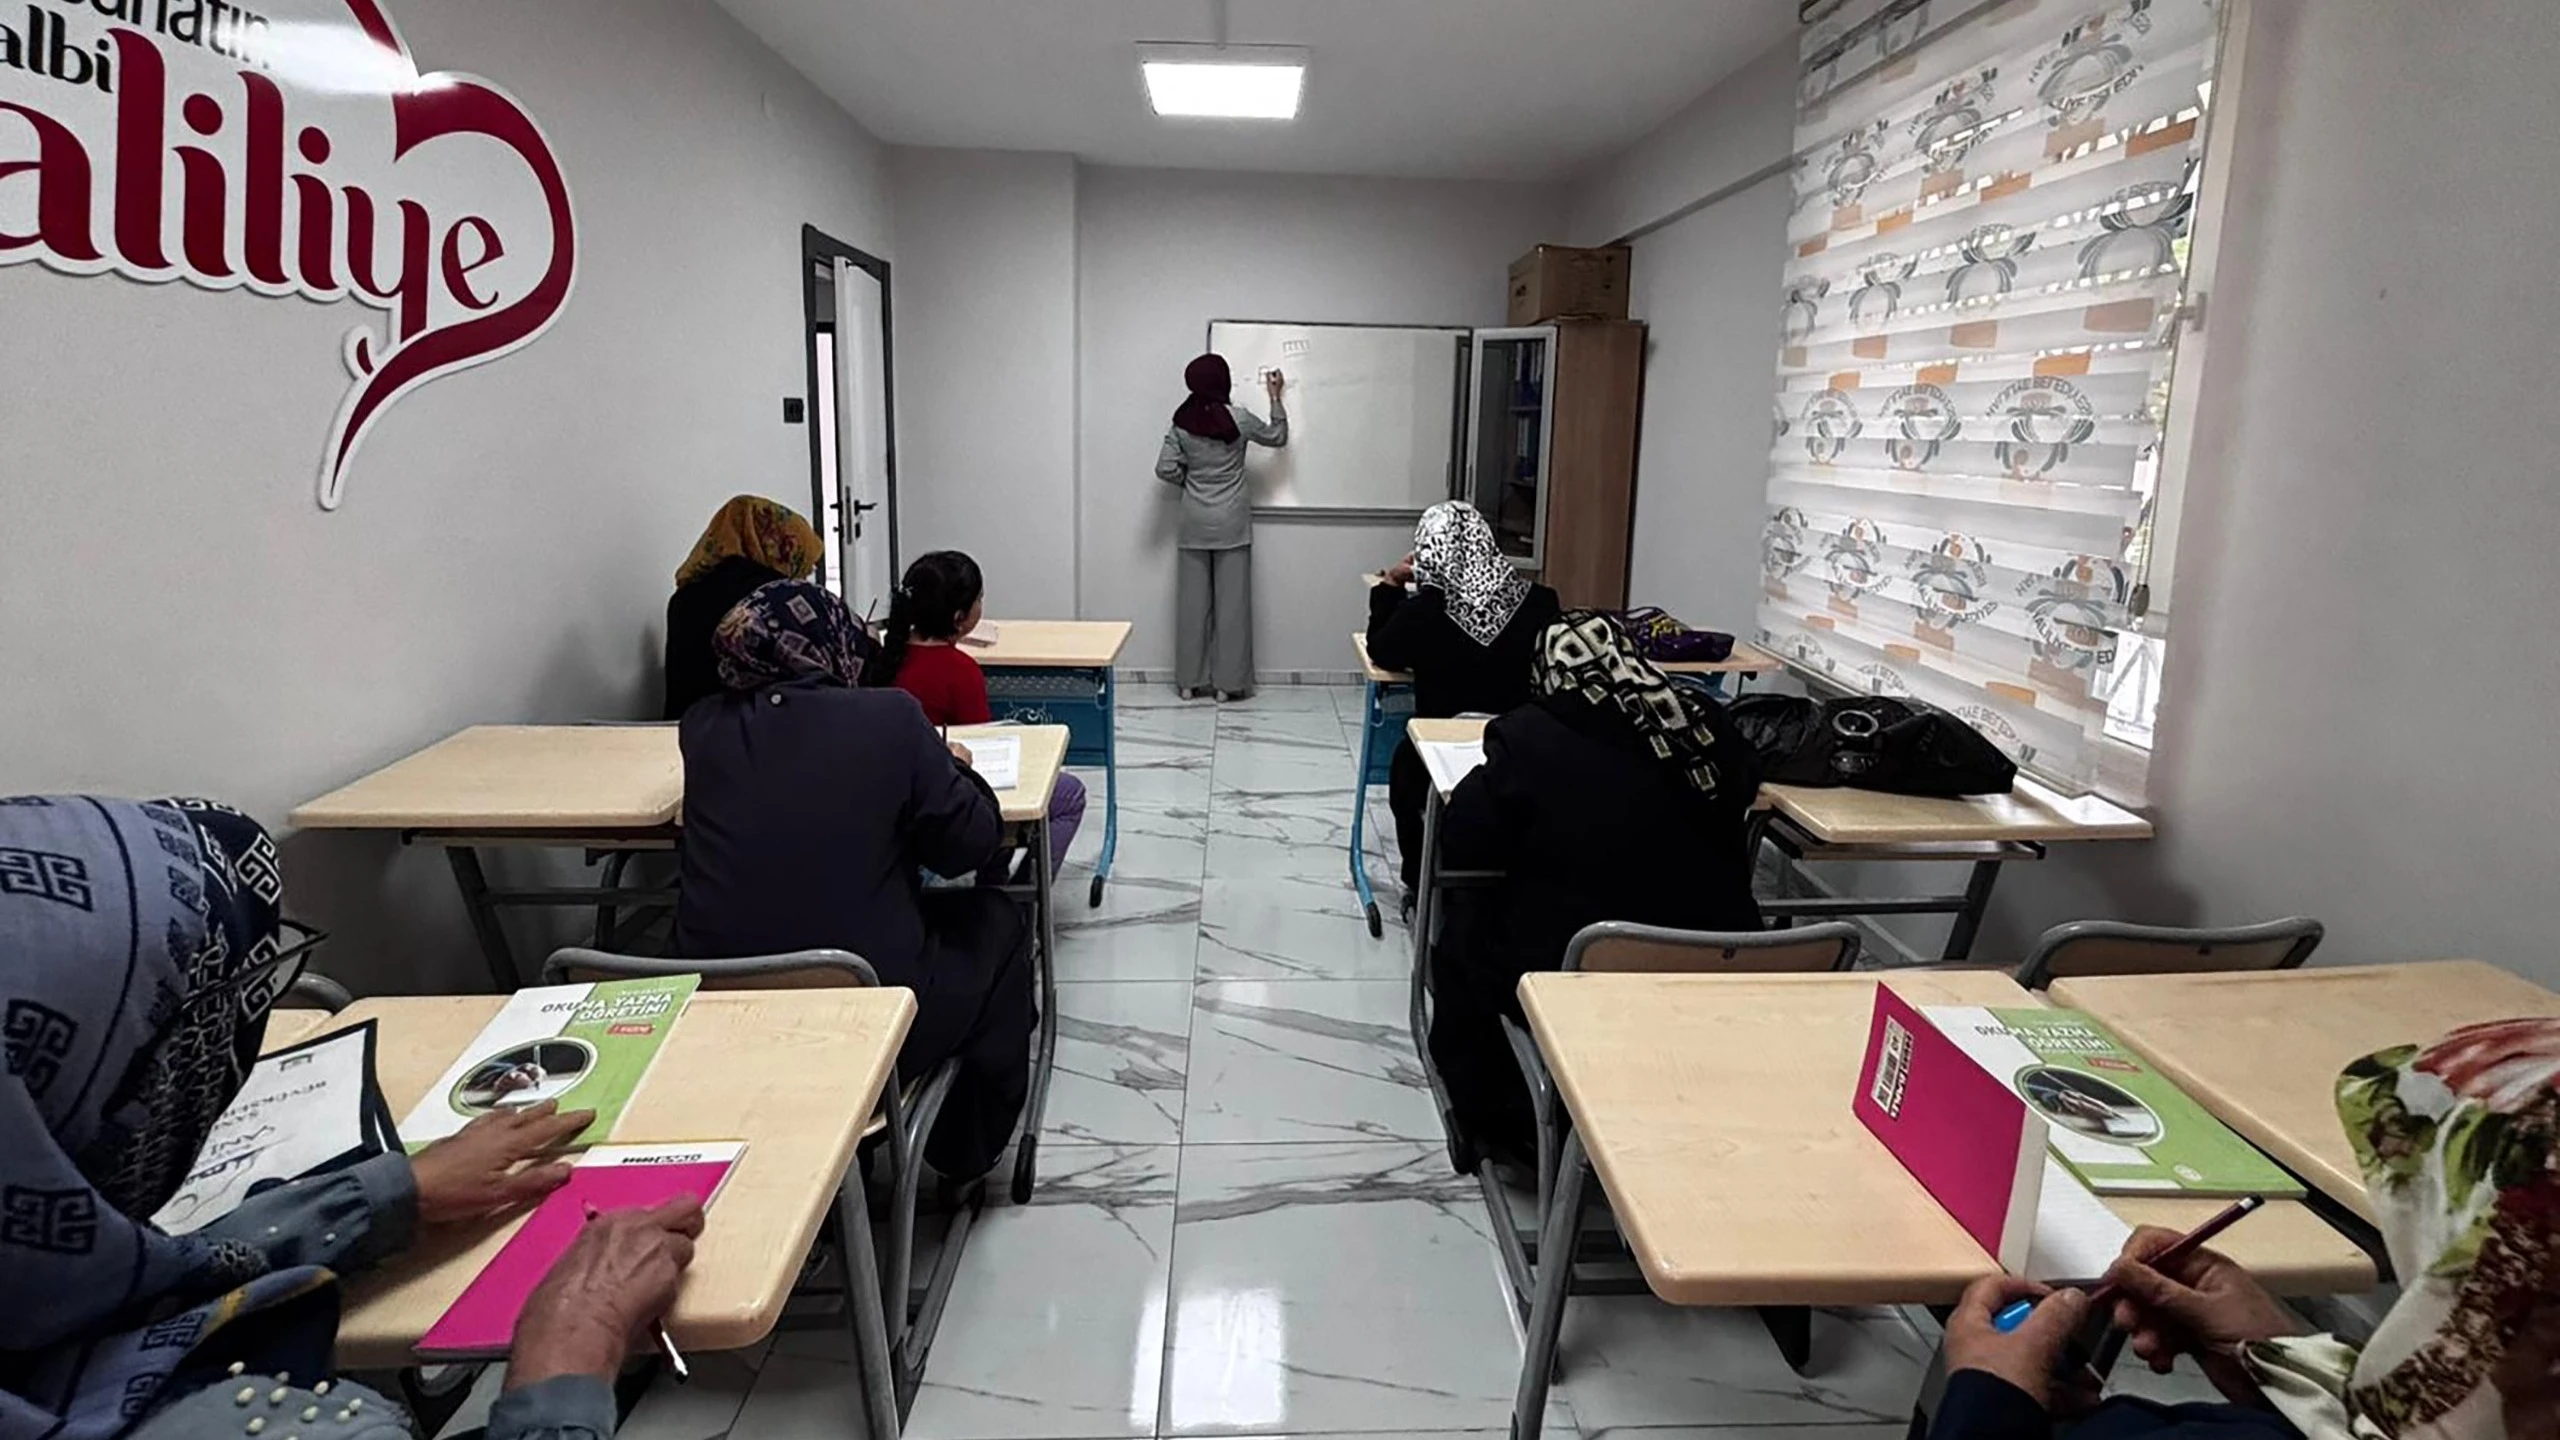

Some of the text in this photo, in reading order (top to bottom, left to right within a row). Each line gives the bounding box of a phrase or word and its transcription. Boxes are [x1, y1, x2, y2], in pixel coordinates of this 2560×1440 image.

[540, 993, 673, 1013] OKUMA YAZMA
[1974, 1025, 2037, 1038] OKUMA
